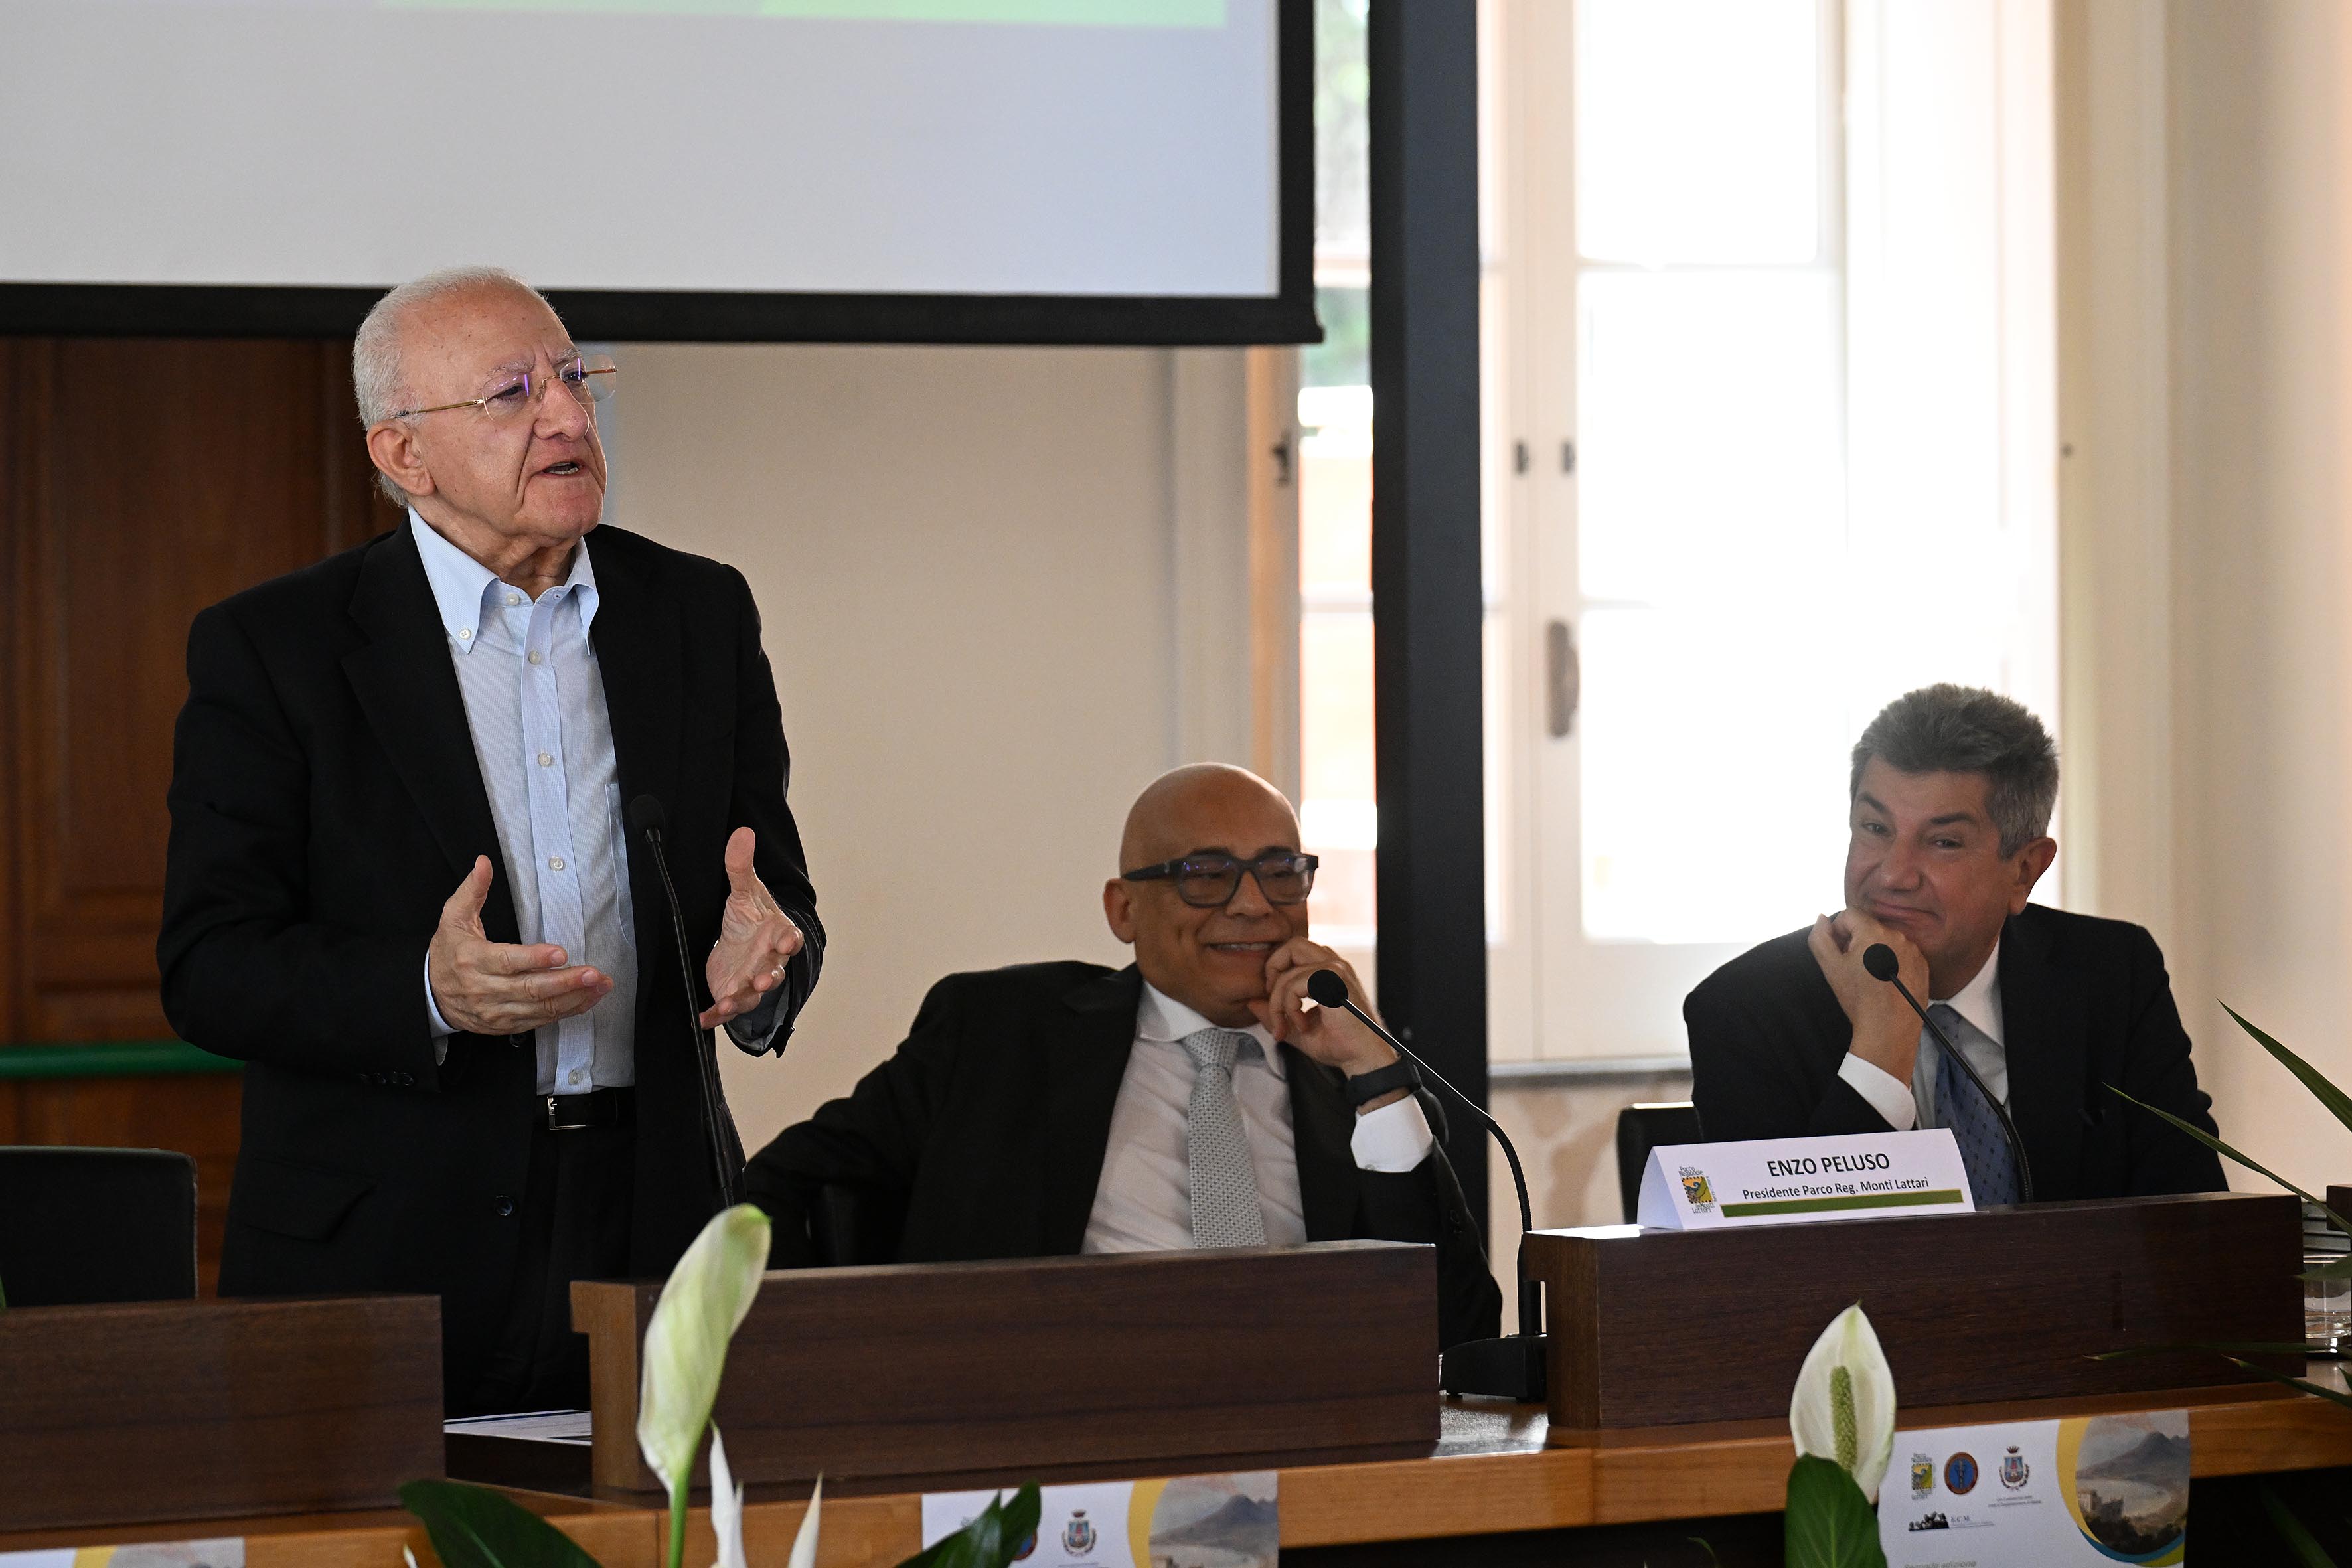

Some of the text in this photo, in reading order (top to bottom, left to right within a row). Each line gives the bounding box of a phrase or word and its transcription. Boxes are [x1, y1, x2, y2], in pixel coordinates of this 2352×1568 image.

[1766, 1153, 1890, 1177] ENZO PELUSO
[1742, 1176, 1930, 1200] Presidente Parco Reg. Monti Lattari
